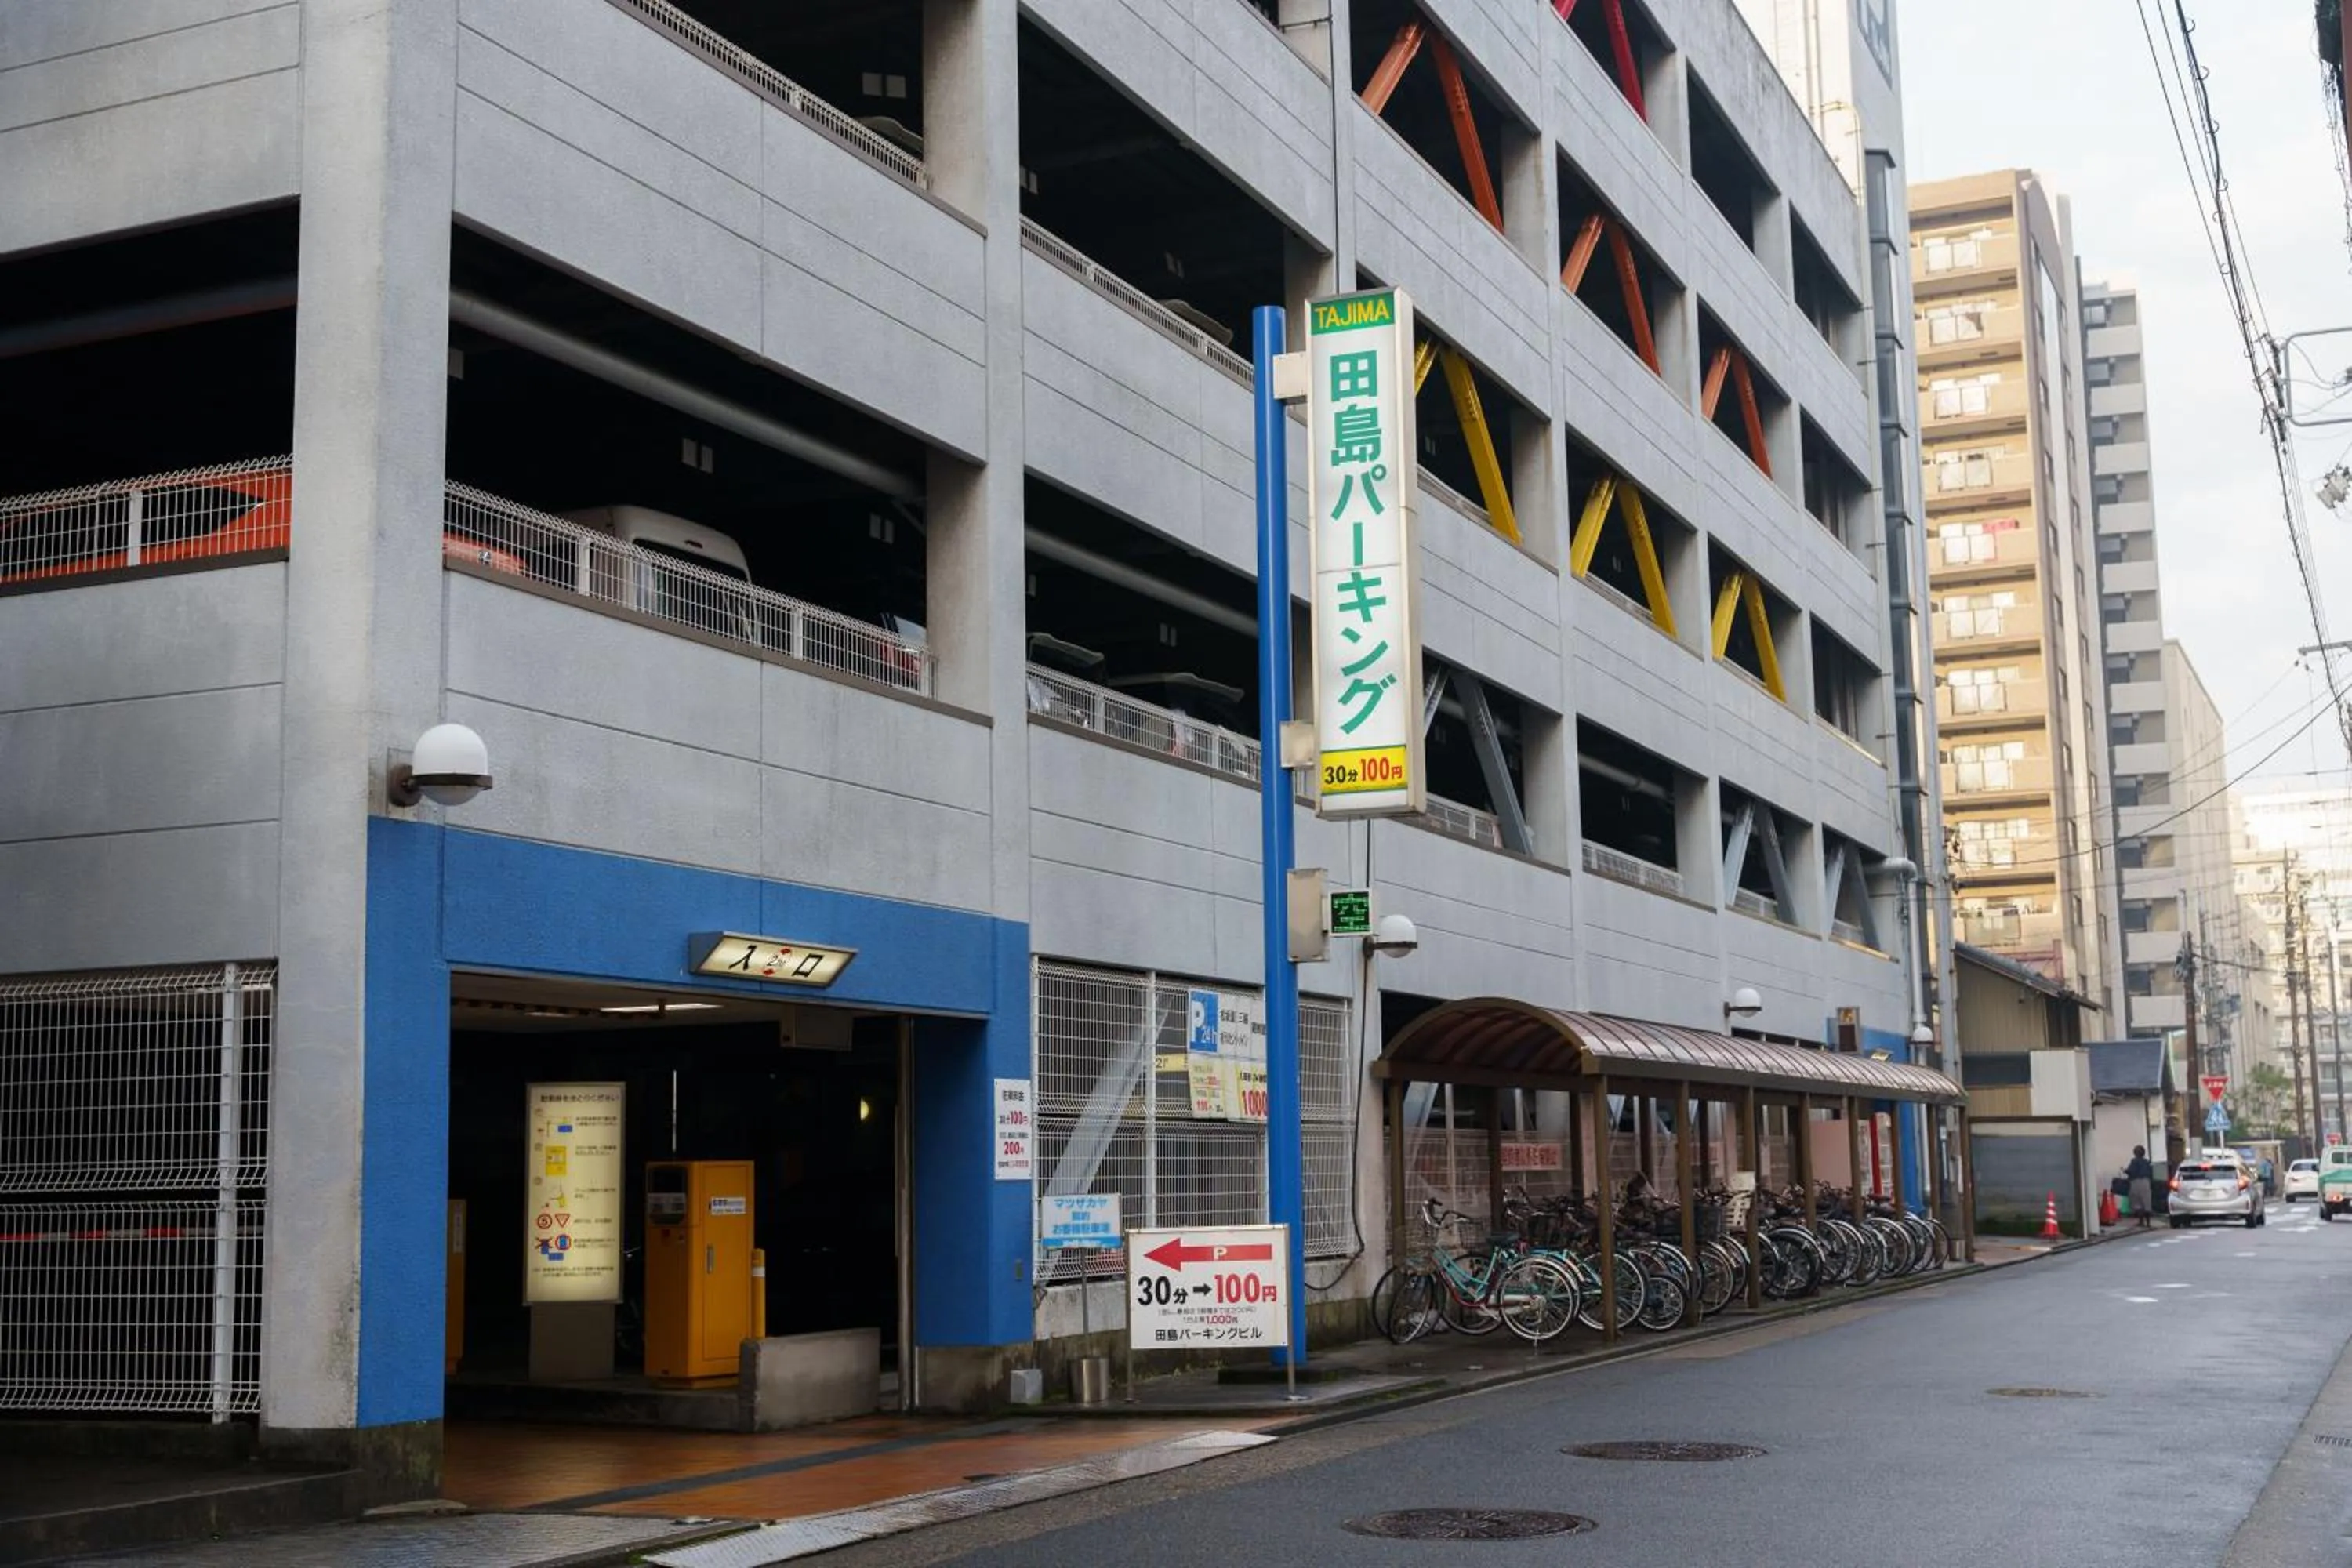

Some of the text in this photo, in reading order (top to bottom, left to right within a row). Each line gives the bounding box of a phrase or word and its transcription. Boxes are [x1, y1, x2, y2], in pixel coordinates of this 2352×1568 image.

[1314, 299, 1389, 328] TAJIMA
[1329, 350, 1398, 734] 田島パーキング
[1324, 757, 1403, 784] 30分 100円
[1191, 1000, 1205, 1043] P
[1053, 1197, 1108, 1209] マツザカヤ
[1213, 1247, 1228, 1260] P
[1138, 1272, 1277, 1305] 30分 100円
[1155, 1326, 1262, 1341] 田島パーキングビル
